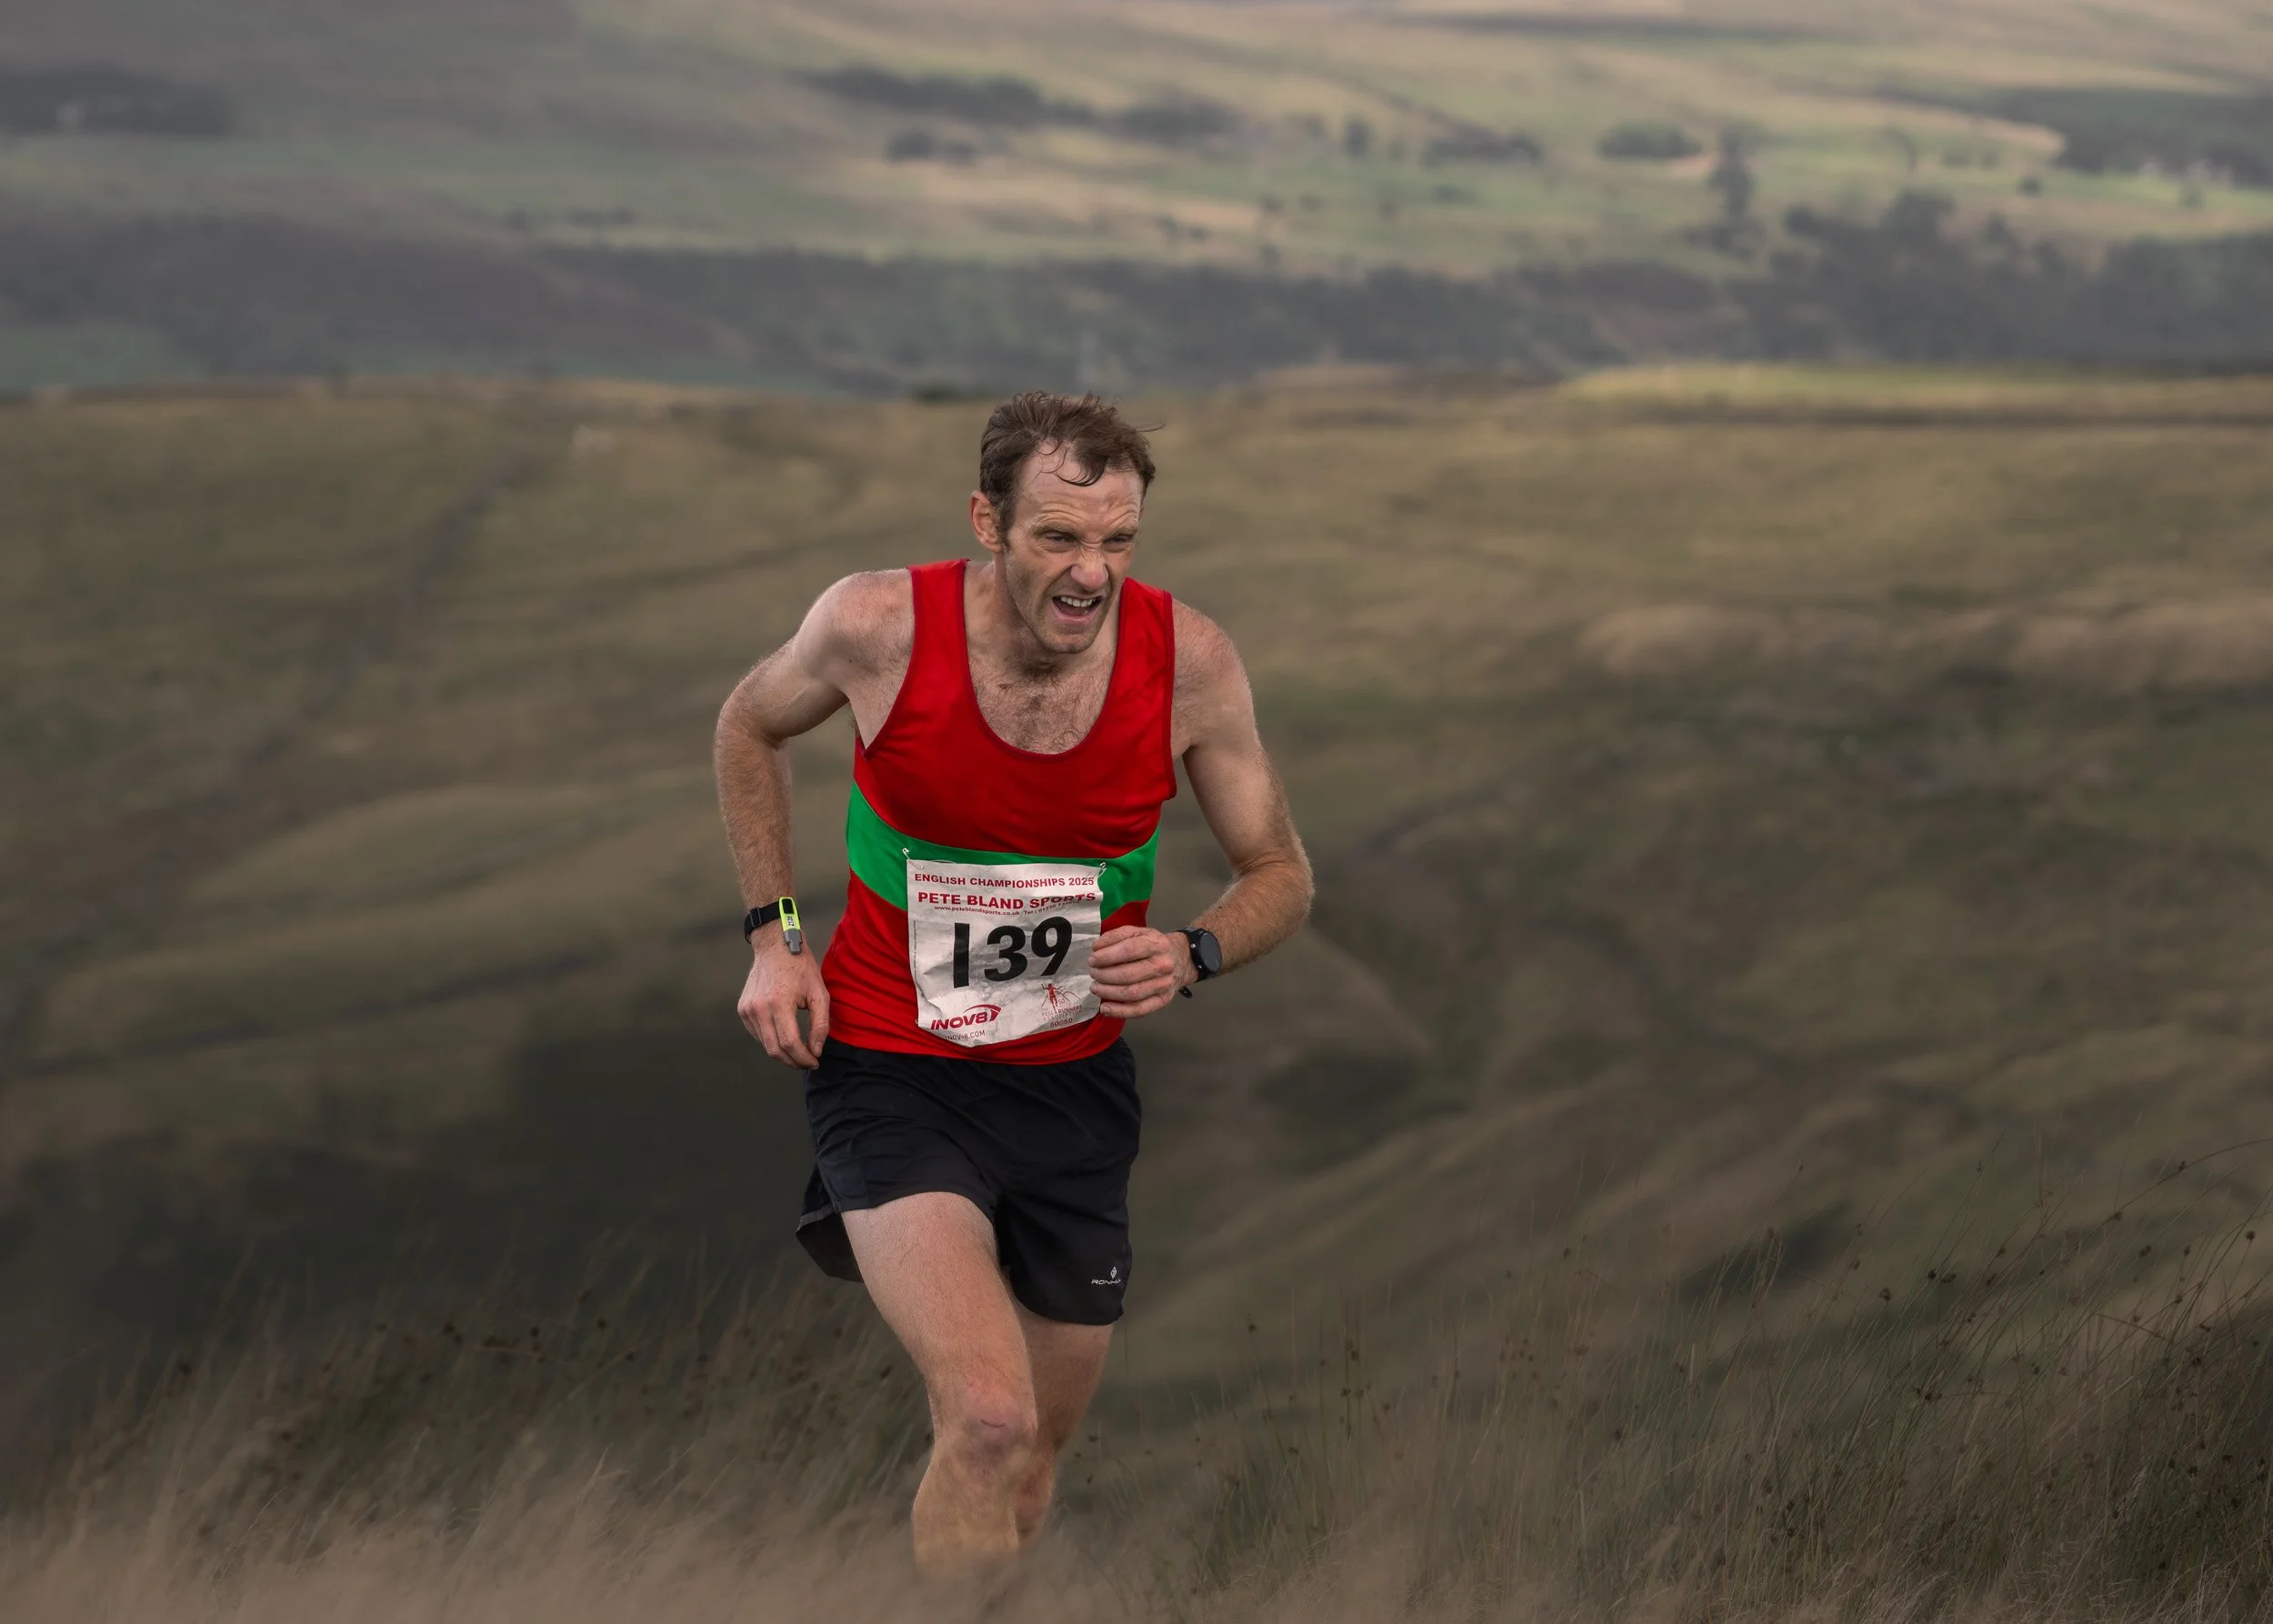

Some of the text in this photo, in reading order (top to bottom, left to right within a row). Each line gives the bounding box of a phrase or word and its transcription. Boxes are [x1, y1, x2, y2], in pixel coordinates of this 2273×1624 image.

[915, 874, 1095, 888] ENGLISH CHAMPIONSHIPS 2025
[918, 892, 1096, 909] PETE BLAND SPORTS
[934, 906, 1020, 916] www.peteblandsports.co.uk
[953, 916, 1073, 989] 139
[930, 1011, 988, 1030] INOV8
[946, 1029, 986, 1041] INOV-8.COM
